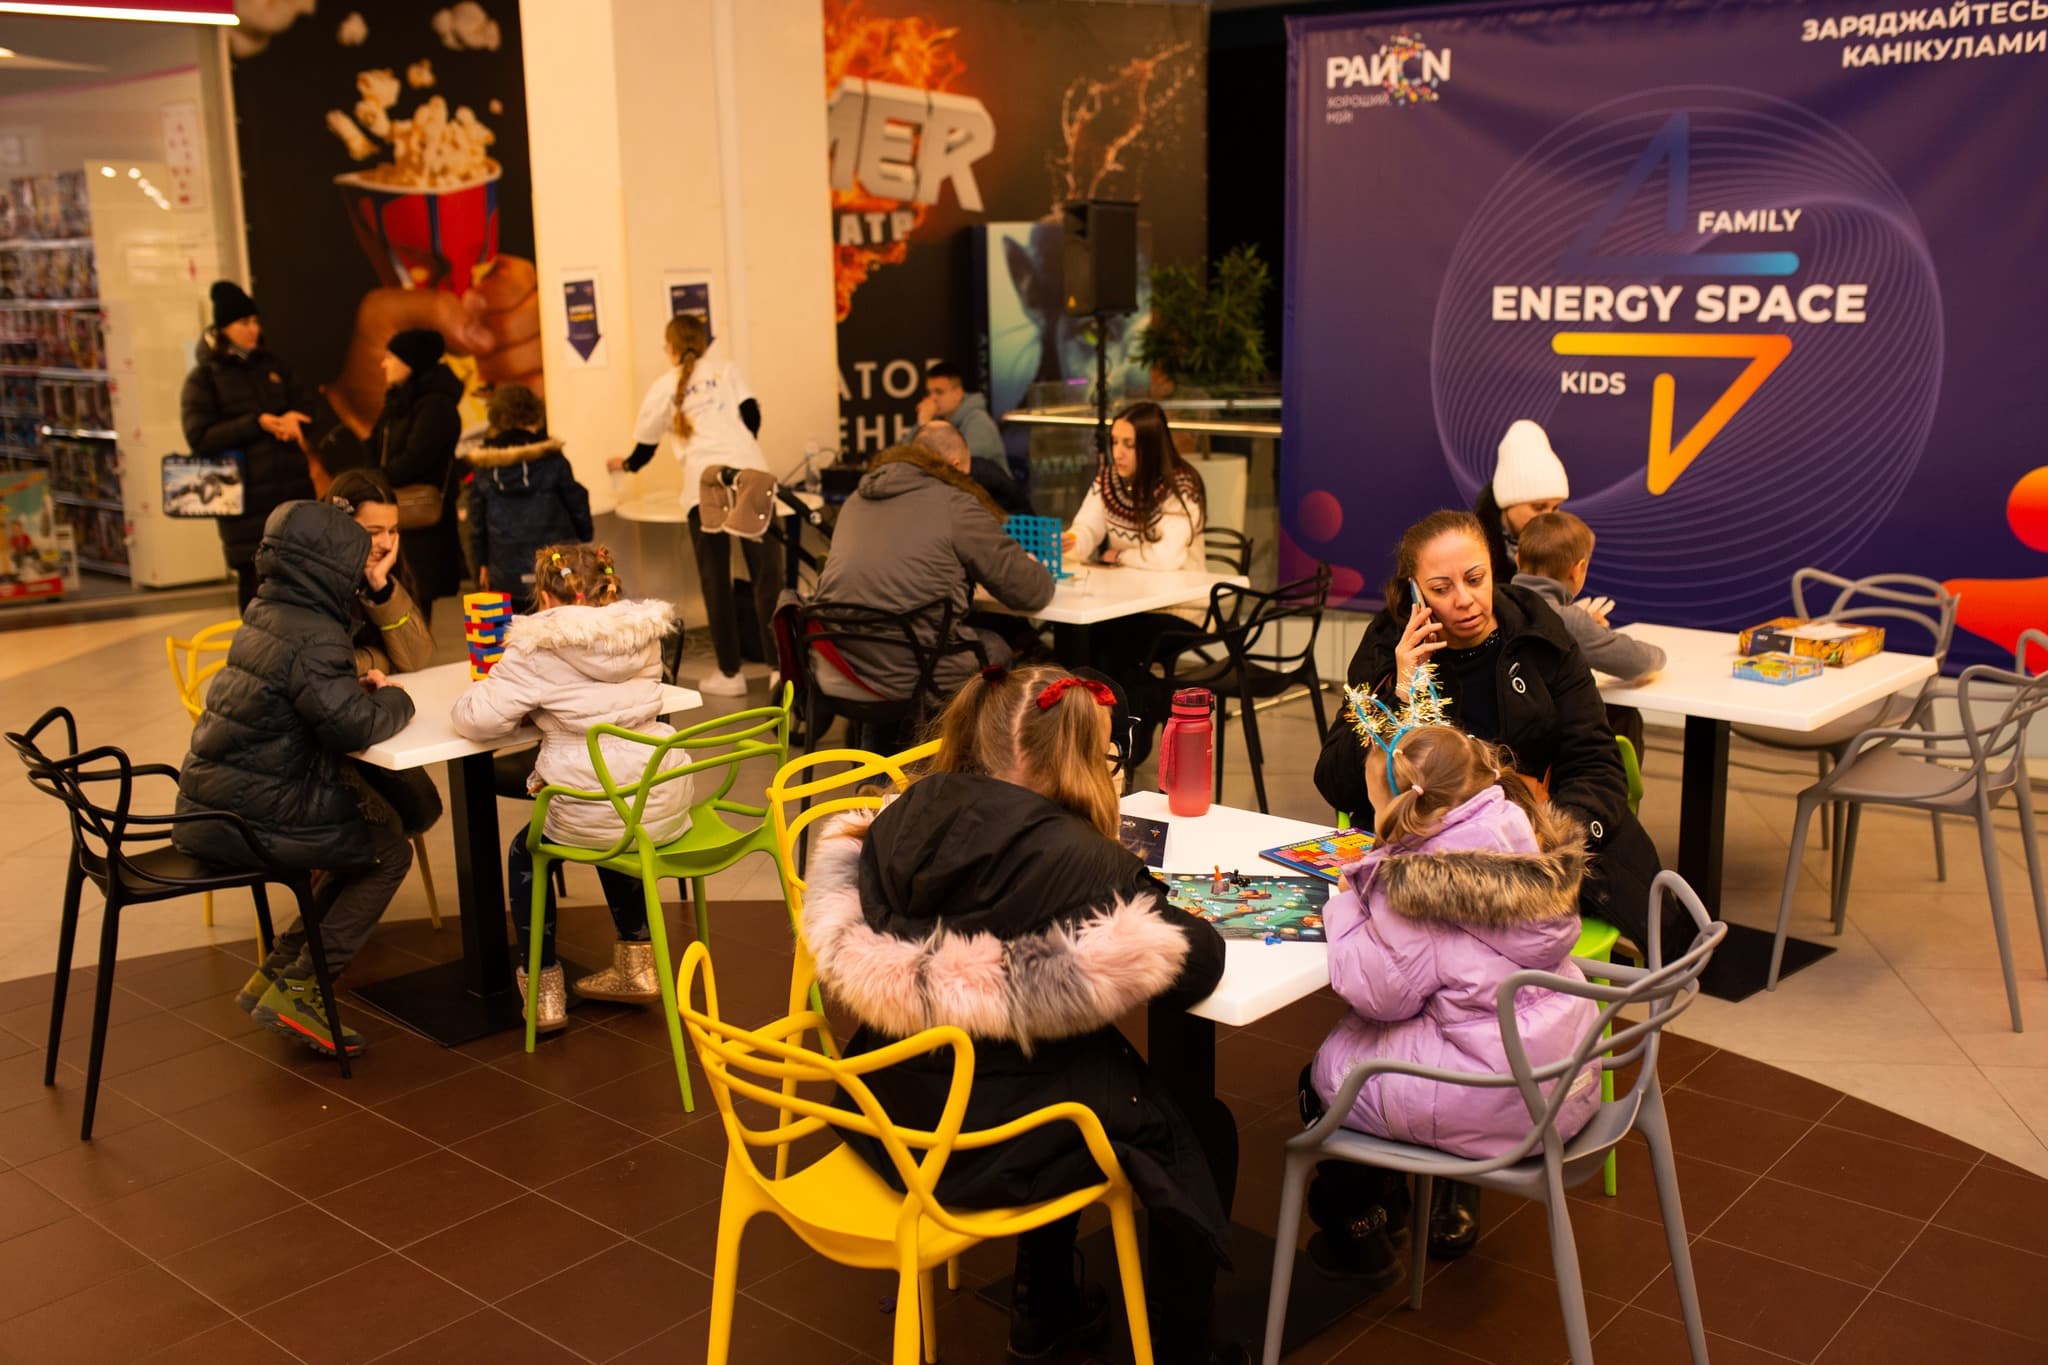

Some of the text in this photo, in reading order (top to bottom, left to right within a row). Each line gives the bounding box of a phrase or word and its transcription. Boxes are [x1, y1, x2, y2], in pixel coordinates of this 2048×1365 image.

[1801, 0, 2048, 42] ЗАРЯДЖАЙТЕСЬ
[1842, 30, 2048, 69] КАНІКУЛАМИ
[1697, 208, 1802, 234] FAMILY
[1491, 284, 1868, 324] ENERGY SPACE
[1560, 371, 1626, 395] KIDS
